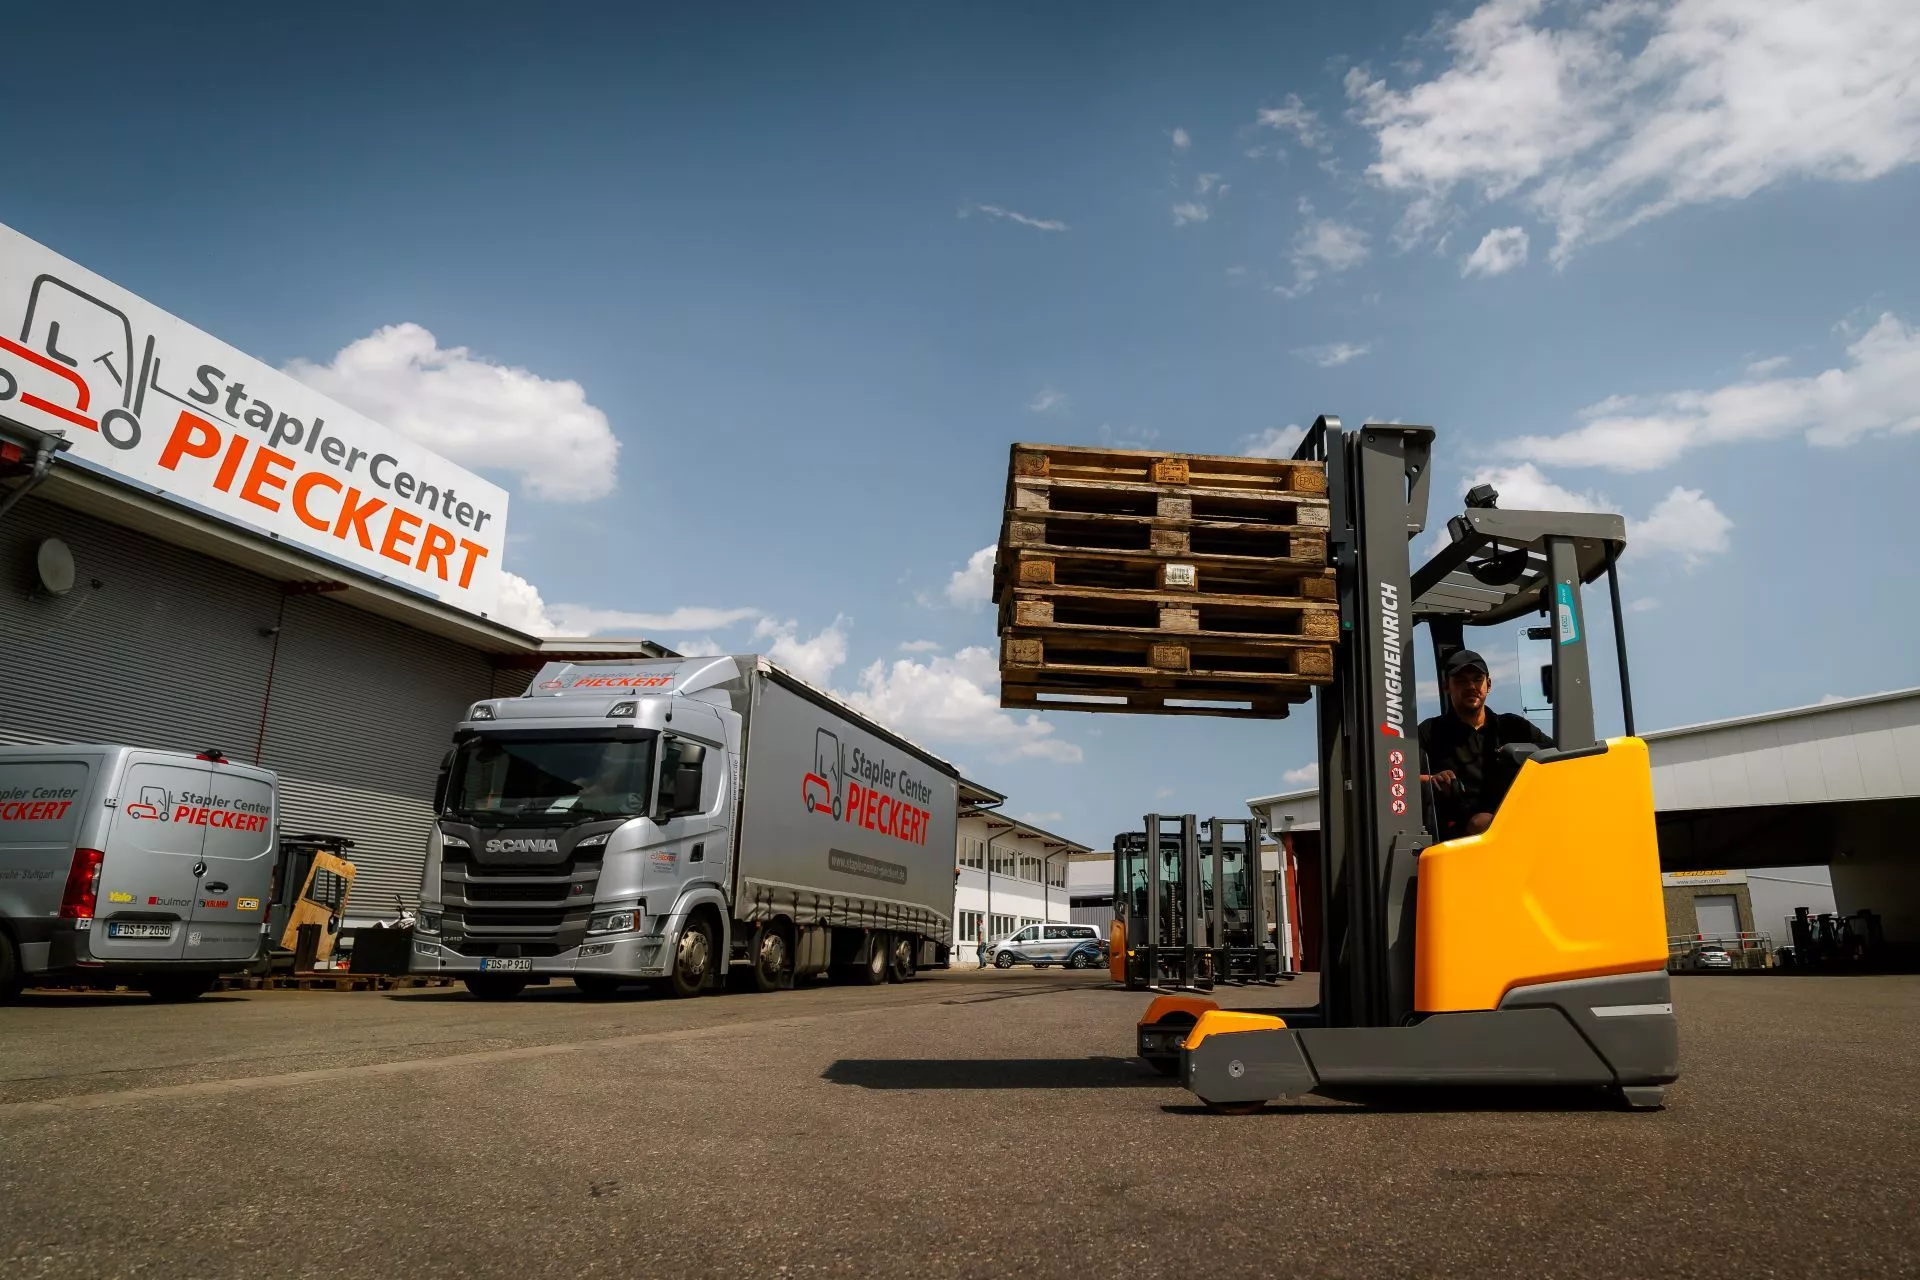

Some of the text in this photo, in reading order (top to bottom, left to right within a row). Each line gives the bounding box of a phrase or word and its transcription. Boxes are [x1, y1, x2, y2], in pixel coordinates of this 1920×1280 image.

[1300, 476, 1318, 485] EPAL
[158, 409, 489, 590] PIECKERT
[1380, 582, 1405, 740] JUNGHEINRICH
[574, 677, 674, 687] PIECKERT
[851, 747, 932, 805] Stapler Center
[32, 787, 78, 799] Center
[180, 791, 271, 814] Stapler Center
[174, 805, 269, 832] PIECKERT
[845, 781, 930, 846] PIECKERT
[485, 838, 558, 853] SCANIA
[117, 924, 170, 935] FDS P 2030
[485, 959, 502, 969] FDS
[514, 960, 530, 970] 910
